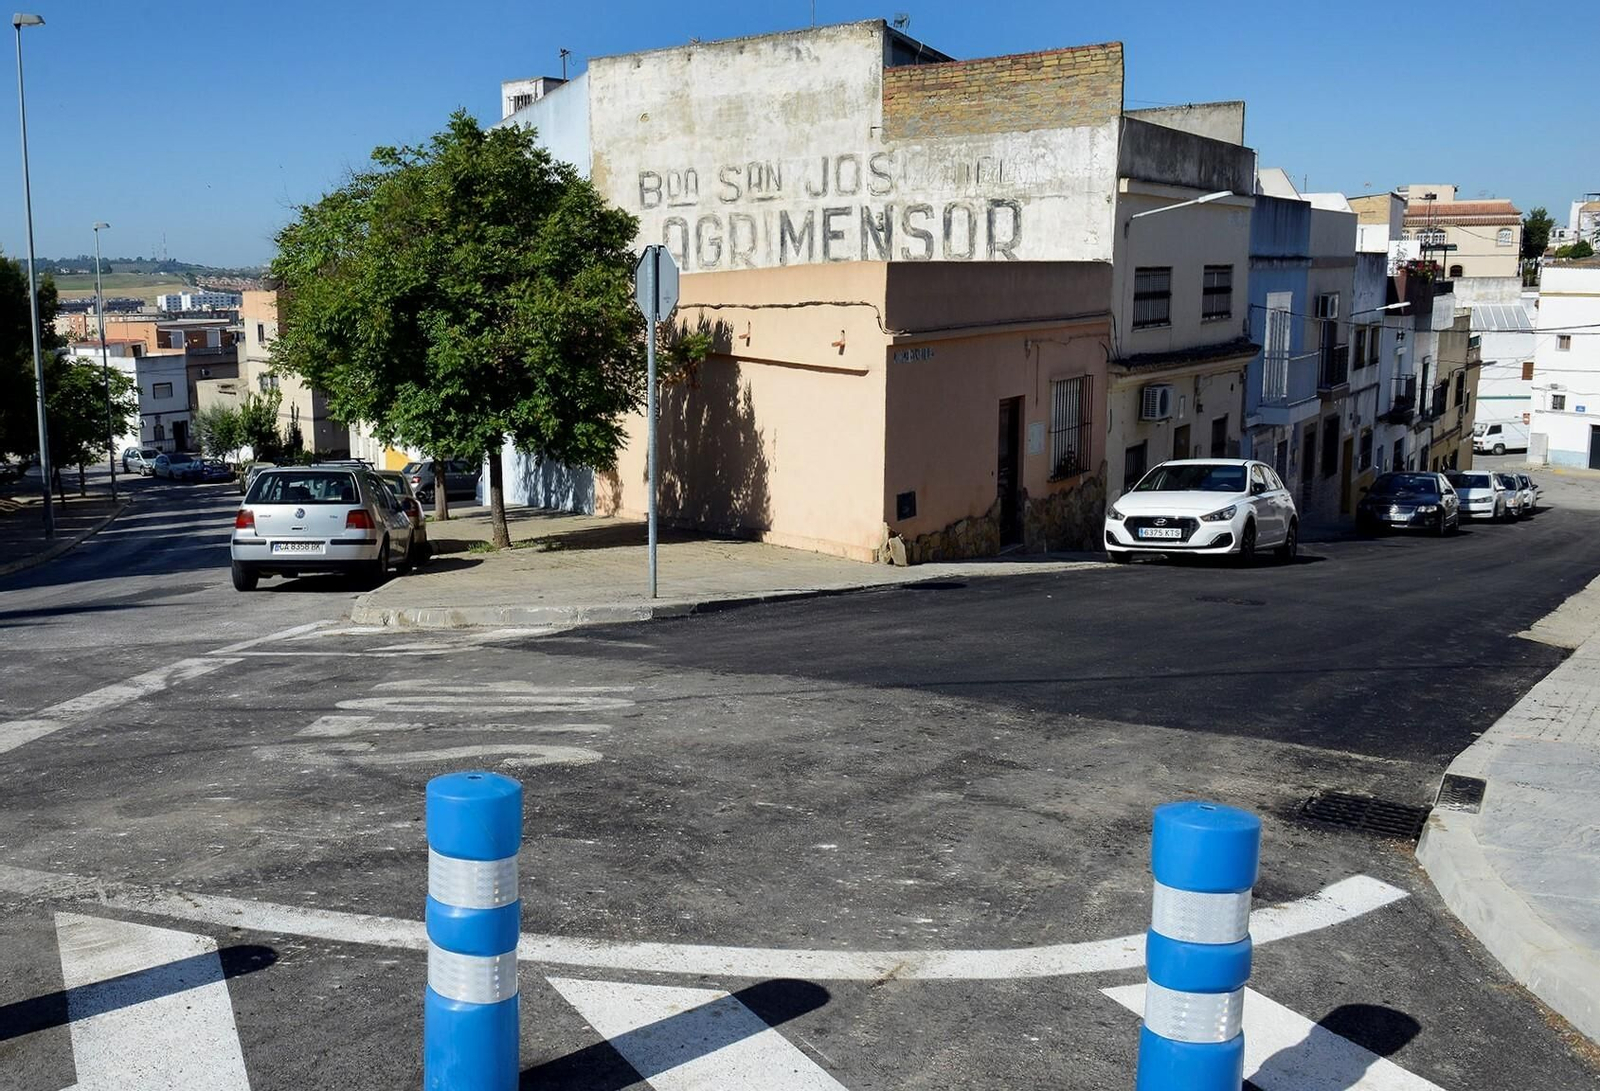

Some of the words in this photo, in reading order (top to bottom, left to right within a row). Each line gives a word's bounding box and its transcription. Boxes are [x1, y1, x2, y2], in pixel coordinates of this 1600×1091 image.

[719, 158, 782, 204] SAN
[805, 151, 908, 197] JOS
[1144, 528, 1163, 537] 6375
